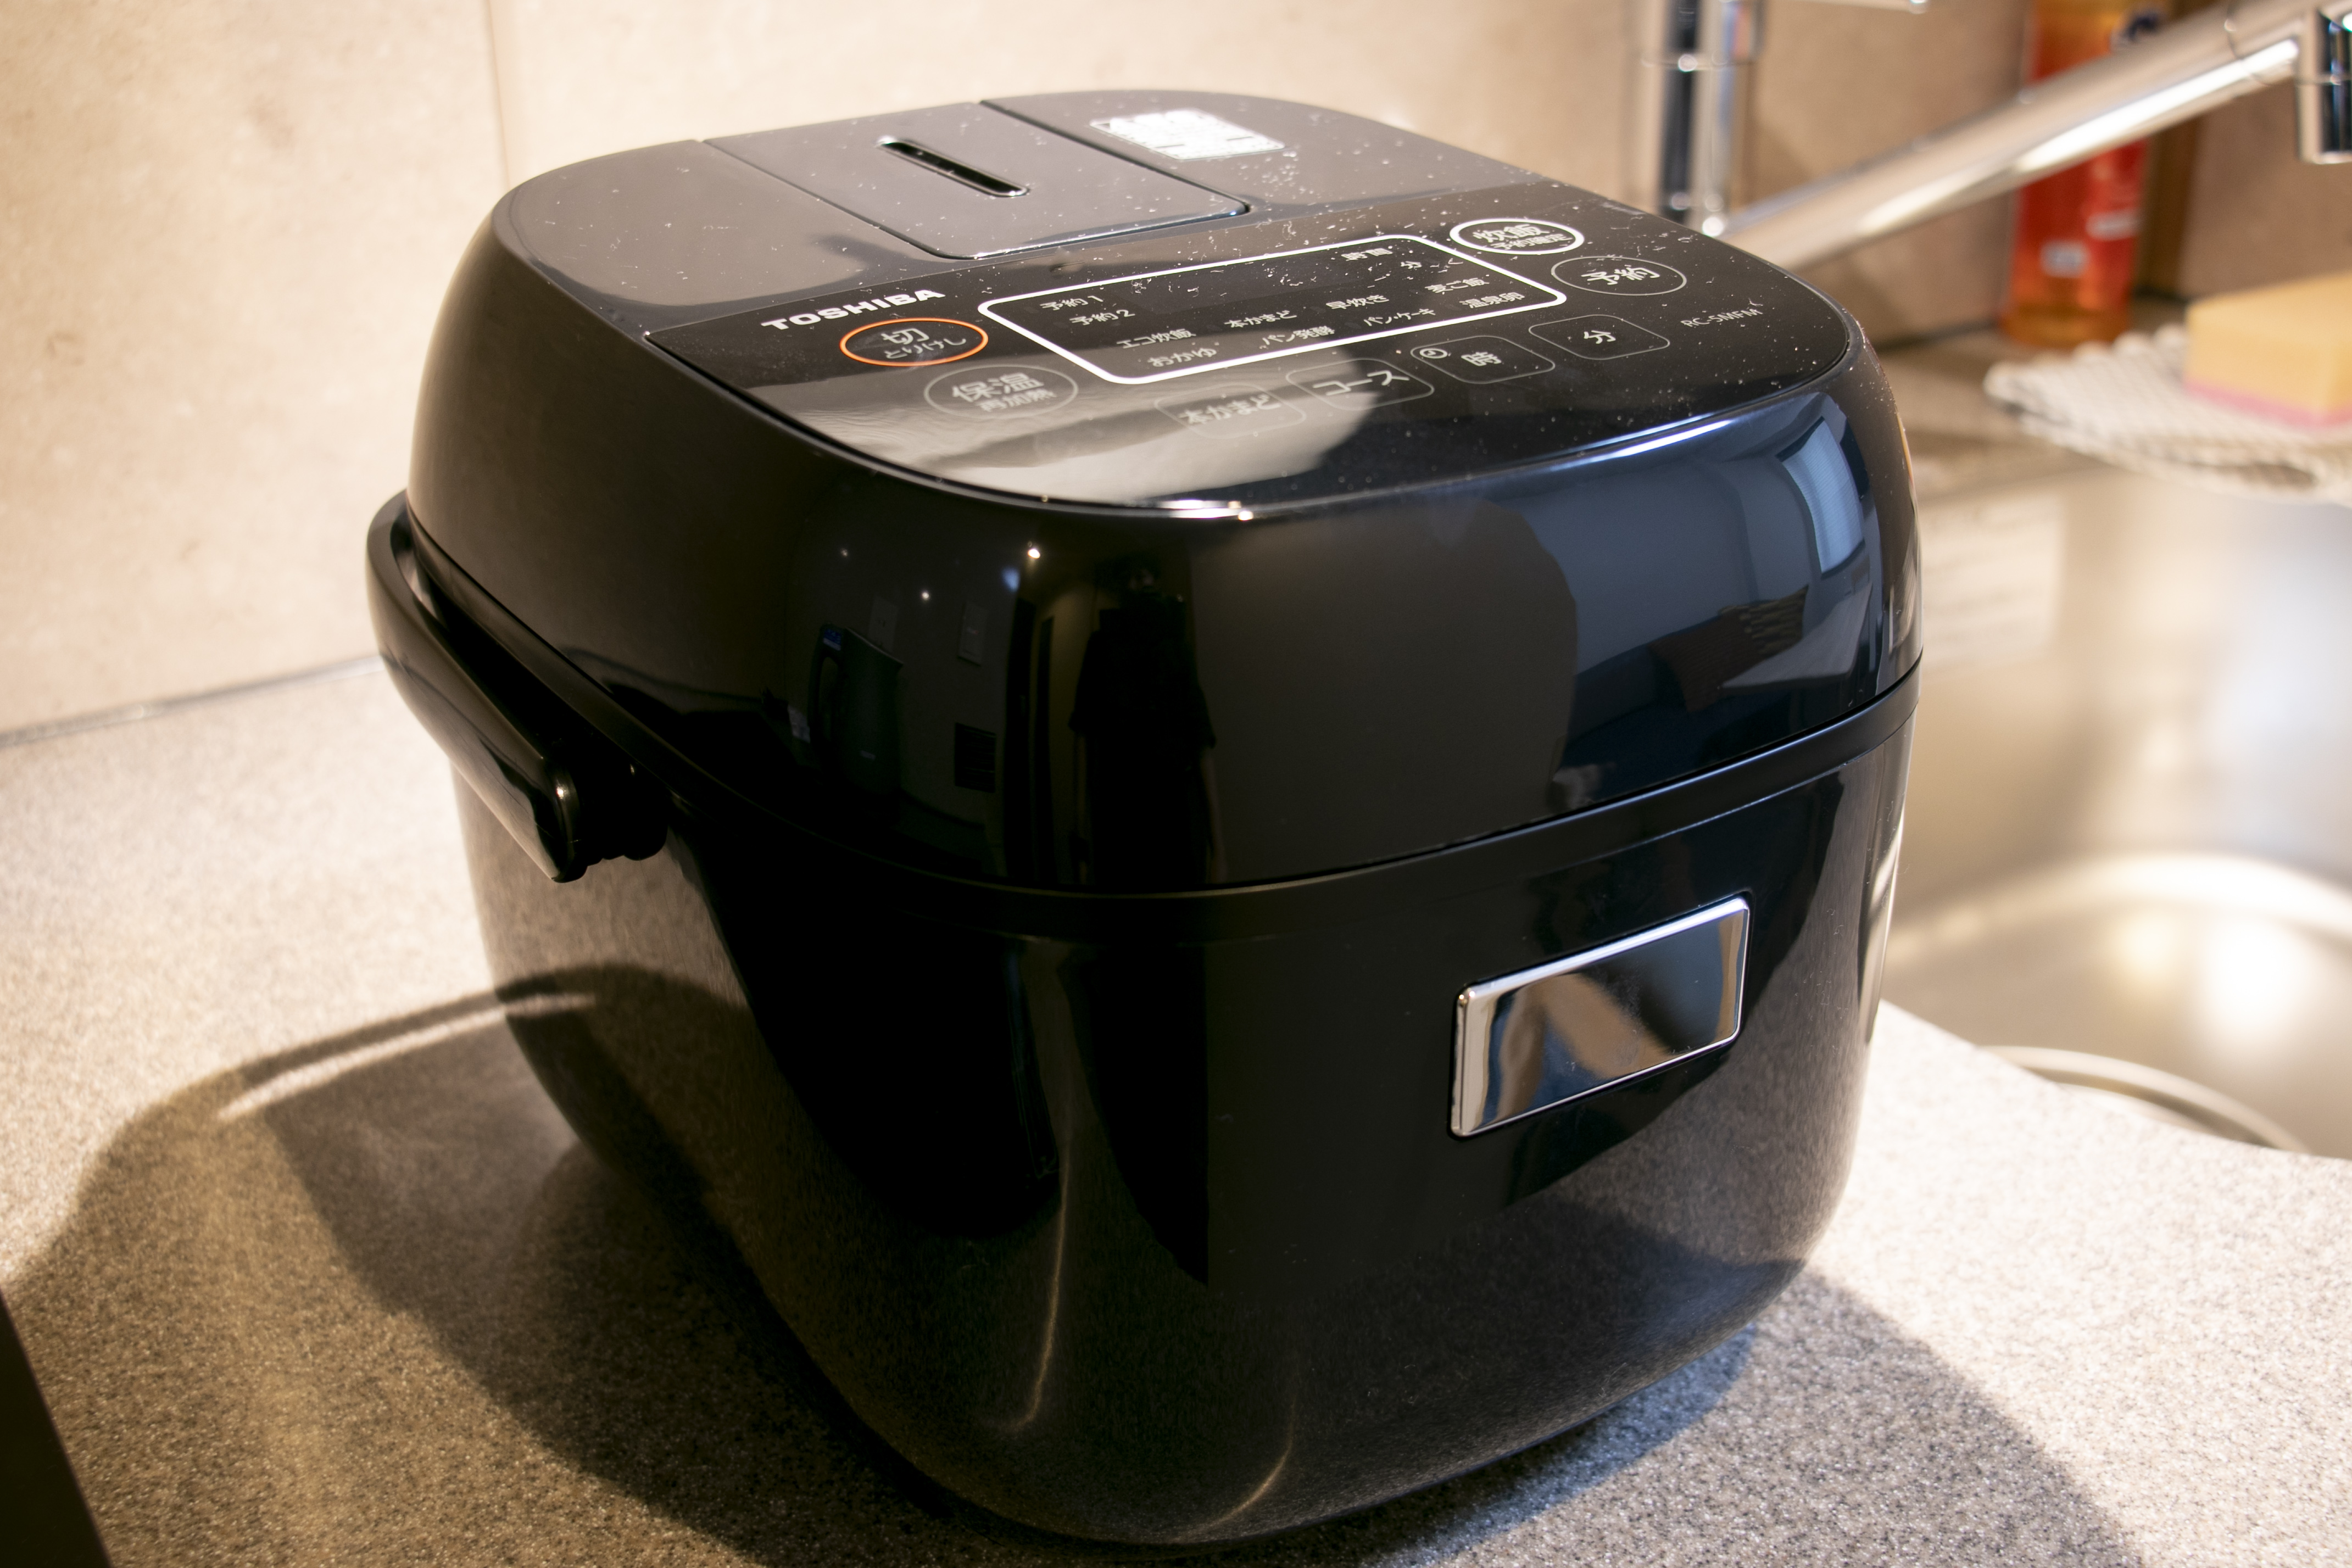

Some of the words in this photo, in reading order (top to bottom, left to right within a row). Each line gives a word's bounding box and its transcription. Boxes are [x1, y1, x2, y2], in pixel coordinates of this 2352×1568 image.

[1473, 224, 1550, 243] 炊飯
[1491, 233, 1573, 250] 予約確定
[1341, 248, 1393, 261] 時間
[1401, 261, 1422, 269] 分
[1581, 267, 1660, 284] 予約
[1424, 277, 1490, 293] 麦ご飯
[761, 289, 945, 330] TOSHIBA
[1326, 295, 1390, 310] 早炊き
[1459, 292, 1525, 309] 温泉卵
[1224, 310, 1297, 328] 本かまど
[1681, 309, 1763, 327] RC-5MFM
[881, 328, 929, 344] 切
[1117, 328, 1196, 349] エコ炊飯
[1263, 326, 1335, 345] パン発酵
[1584, 330, 1616, 344] 分
[884, 338, 966, 359] とりけし
[1147, 348, 1217, 367] おかゆ
[1461, 351, 1501, 366] 時
[952, 372, 1044, 402] 保温
[1313, 370, 1409, 395] コース
[975, 388, 1057, 412] 再加熱
[1179, 394, 1281, 425] 本かまど
